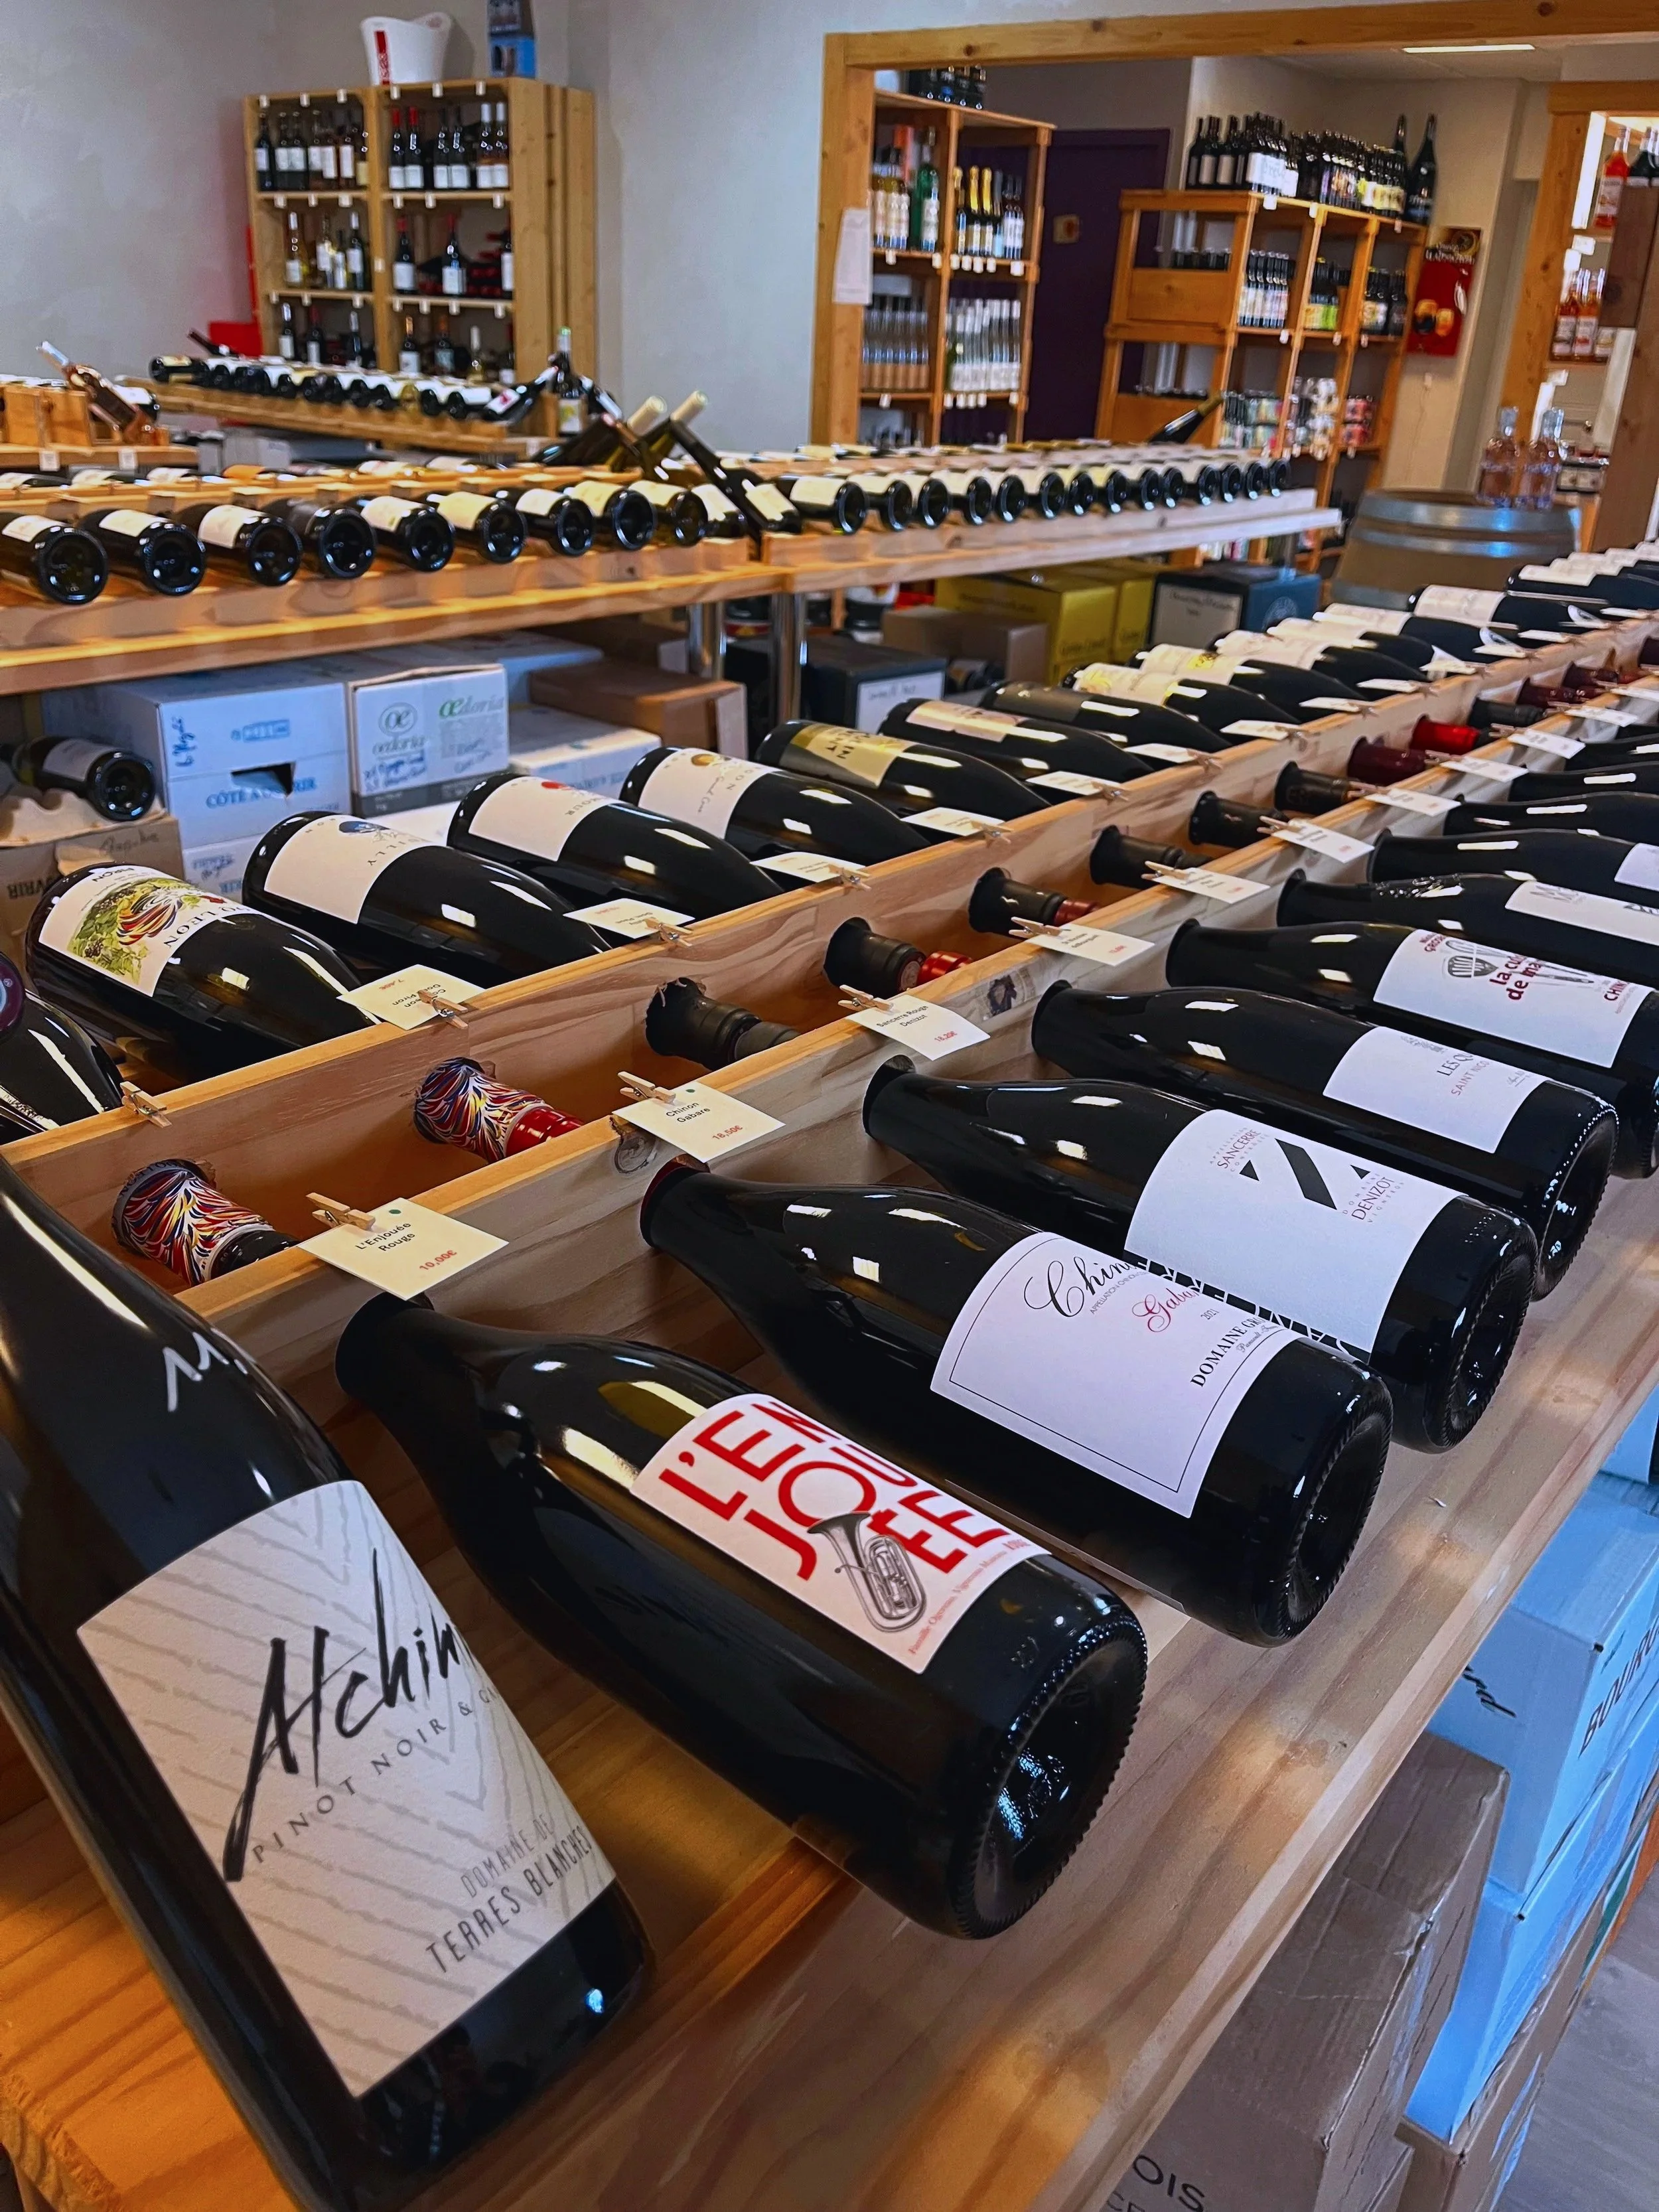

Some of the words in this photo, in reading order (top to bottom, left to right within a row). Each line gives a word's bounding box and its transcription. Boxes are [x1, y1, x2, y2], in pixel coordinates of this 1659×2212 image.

[1505, 979, 1529, 1001] de
[666, 1102, 700, 1118] Chinon
[676, 1108, 711, 1124] Gabare
[712, 1125, 743, 1141] 18,50€
[1217, 1129, 1260, 1169] SANCERRE
[1351, 1176, 1396, 1221] DENIZOT
[354, 1222, 411, 1250] L'Enjouée
[378, 1232, 415, 1252] Rouge
[419, 1250, 457, 1271] 10,00€
[1200, 1308, 1220, 1321] 2021
[1189, 1325, 1248, 1388] DOMAINE
[252, 1777, 357, 1864] PINOT
[370, 1718, 447, 1775] NOIR
[458, 1700, 473, 1717] &
[460, 1829, 534, 1898] DOMAINE
[425, 1886, 521, 1973] TERRES
[523, 1826, 593, 1897] BLANCHES
